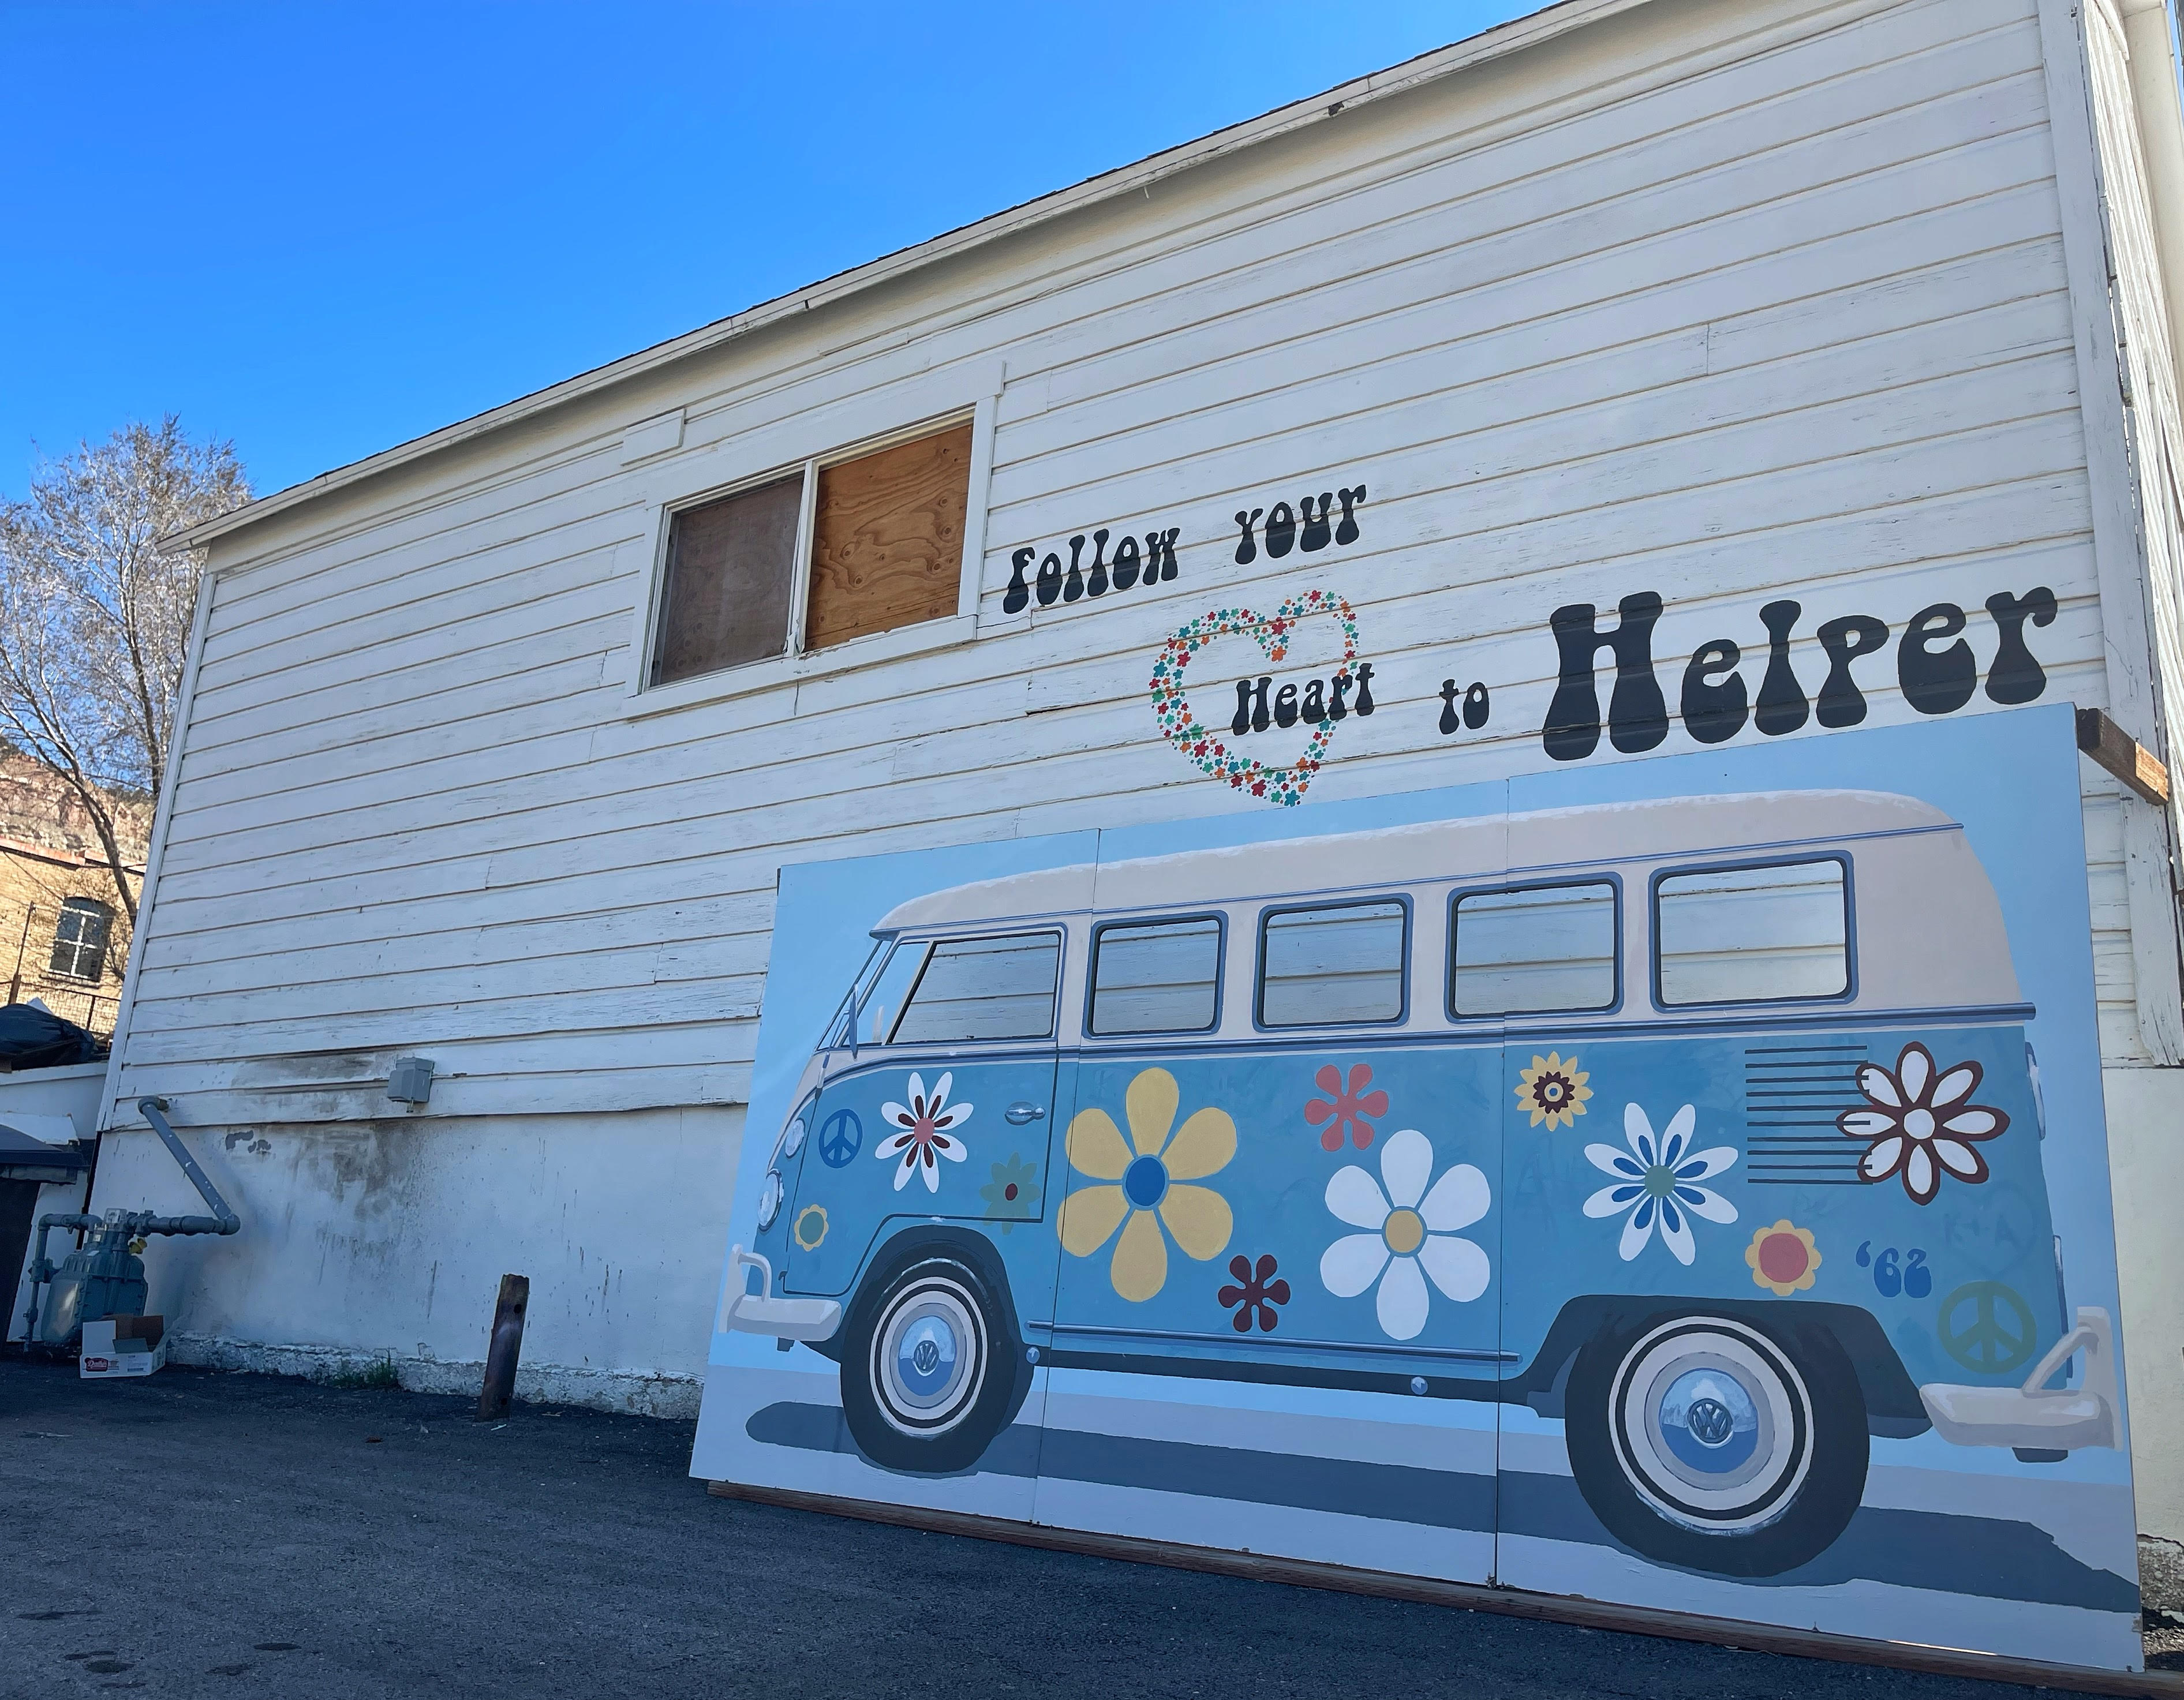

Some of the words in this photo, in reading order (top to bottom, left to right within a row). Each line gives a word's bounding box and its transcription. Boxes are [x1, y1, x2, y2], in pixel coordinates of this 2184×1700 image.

[1231, 662, 1375, 736] Heart
[1438, 679, 1490, 735] to
[1543, 586, 2058, 761] Helper
